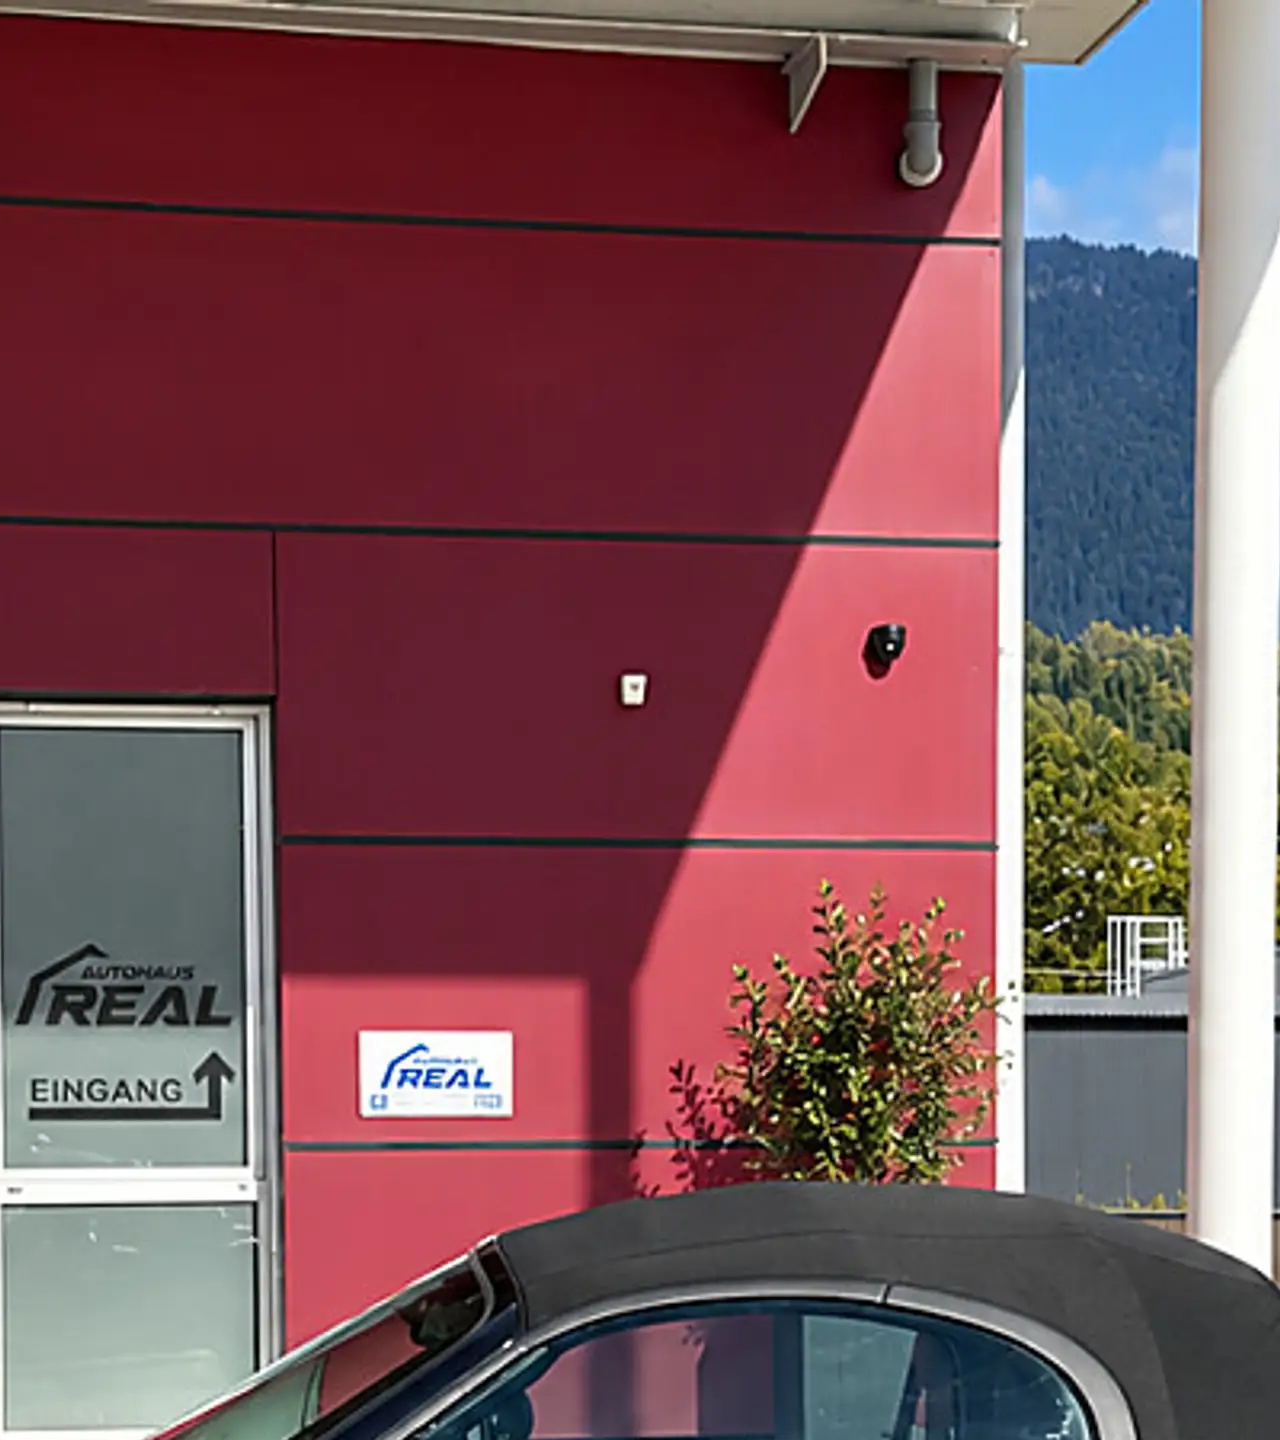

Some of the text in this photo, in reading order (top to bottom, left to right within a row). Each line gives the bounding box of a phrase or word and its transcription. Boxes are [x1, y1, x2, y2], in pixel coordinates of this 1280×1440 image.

[80, 965, 196, 981] AUTOHAUS
[45, 985, 233, 1027] REAL
[396, 1067, 493, 1089] REAL
[30, 1078, 183, 1103] EINGANG
